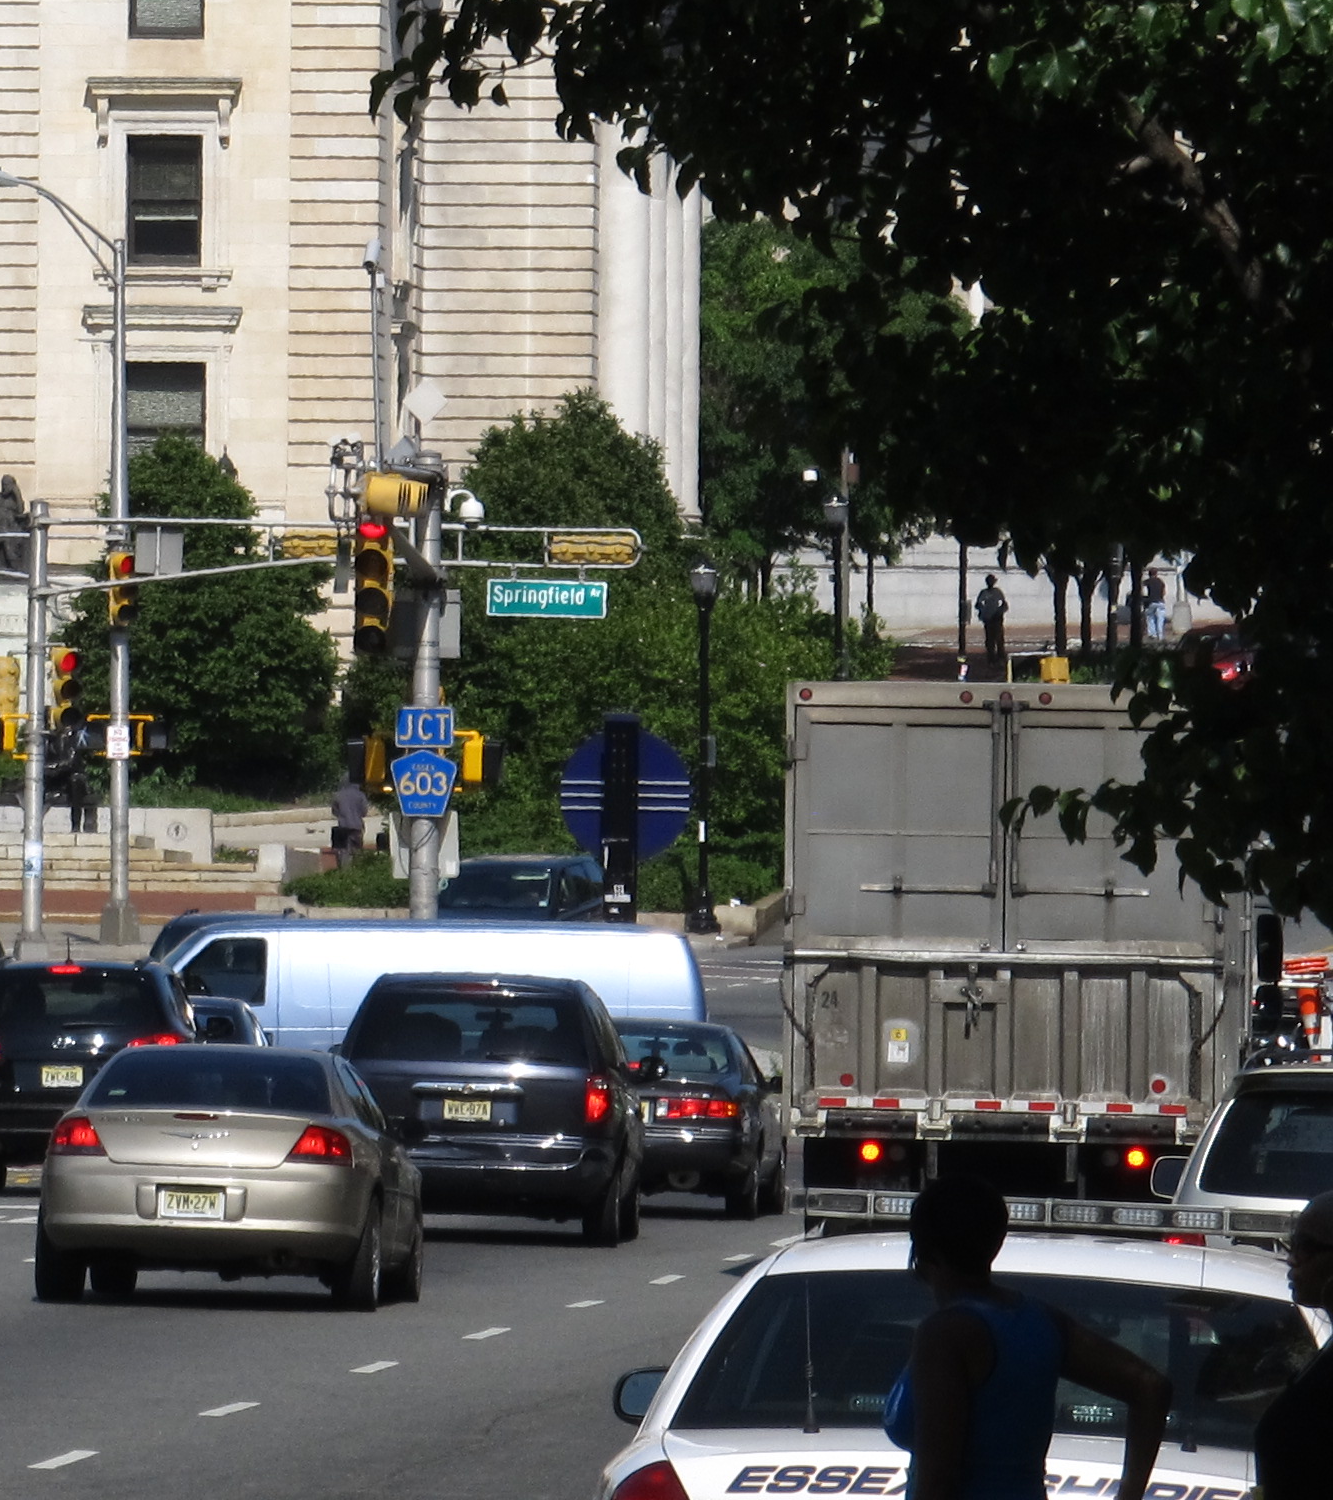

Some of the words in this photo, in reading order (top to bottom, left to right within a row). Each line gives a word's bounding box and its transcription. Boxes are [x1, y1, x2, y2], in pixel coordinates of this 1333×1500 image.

[493, 585, 585, 610] Springfield
[399, 713, 450, 741] JCT
[399, 771, 448, 796] 603
[821, 990, 838, 1009] 24
